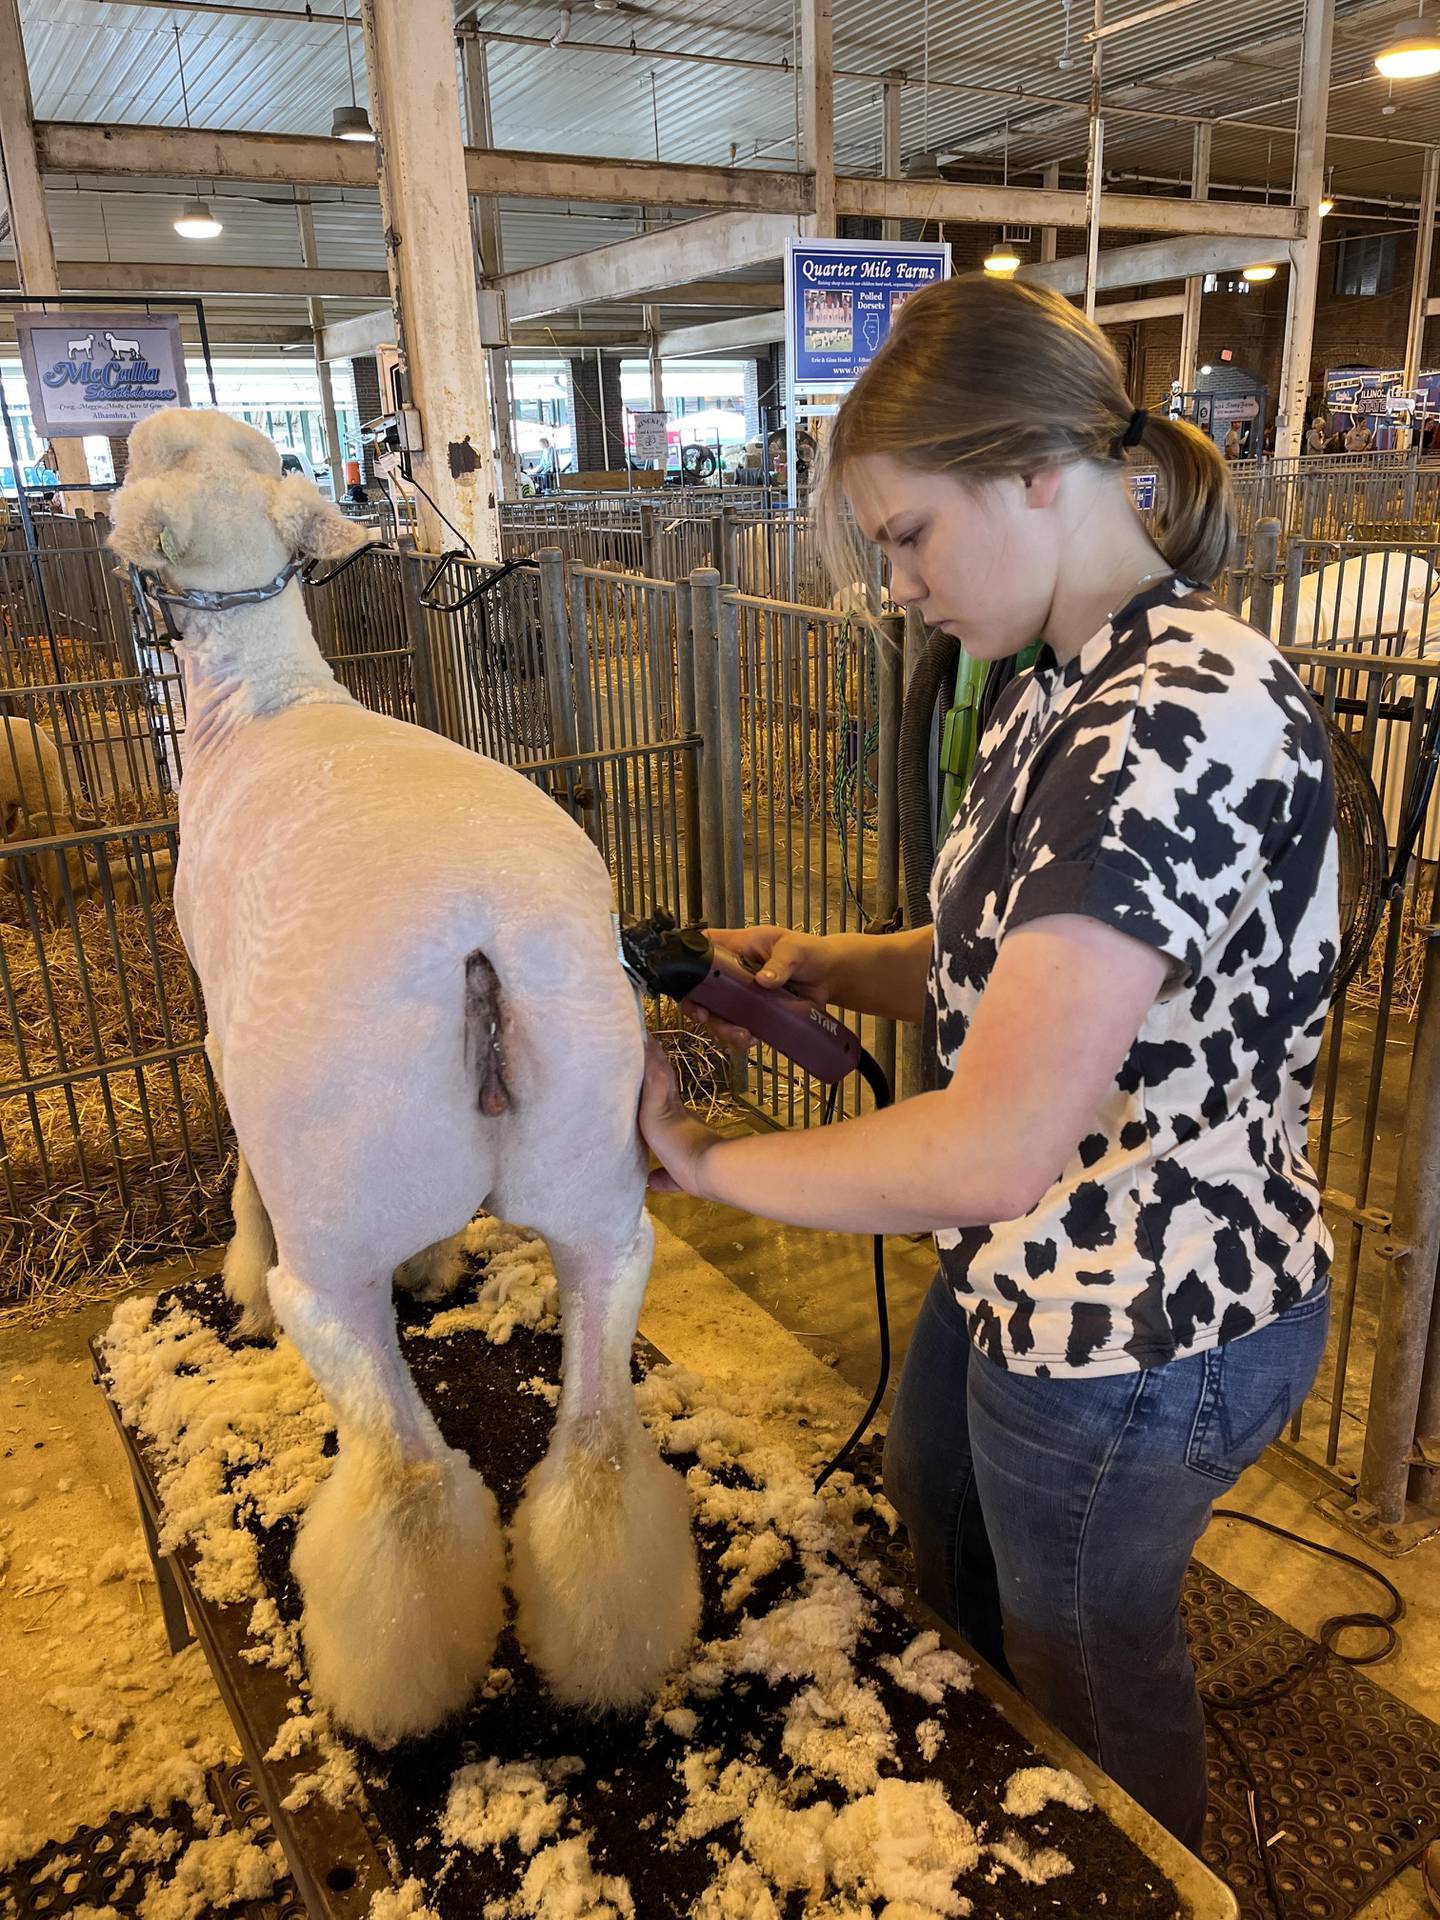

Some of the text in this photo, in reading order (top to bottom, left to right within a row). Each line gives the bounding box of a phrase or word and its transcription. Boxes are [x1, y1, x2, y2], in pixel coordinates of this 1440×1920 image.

[802, 260, 936, 282] Quarter Mile Farms
[859, 291, 883, 301] Polled
[857, 301, 886, 310] Dorsets
[42, 360, 160, 389] McCalla
[83, 383, 177, 402] Southdowns
[1358, 399, 1387, 413] STATE
[92, 411, 129, 420] Alhambra,
[809, 1007, 838, 1036] STAR
